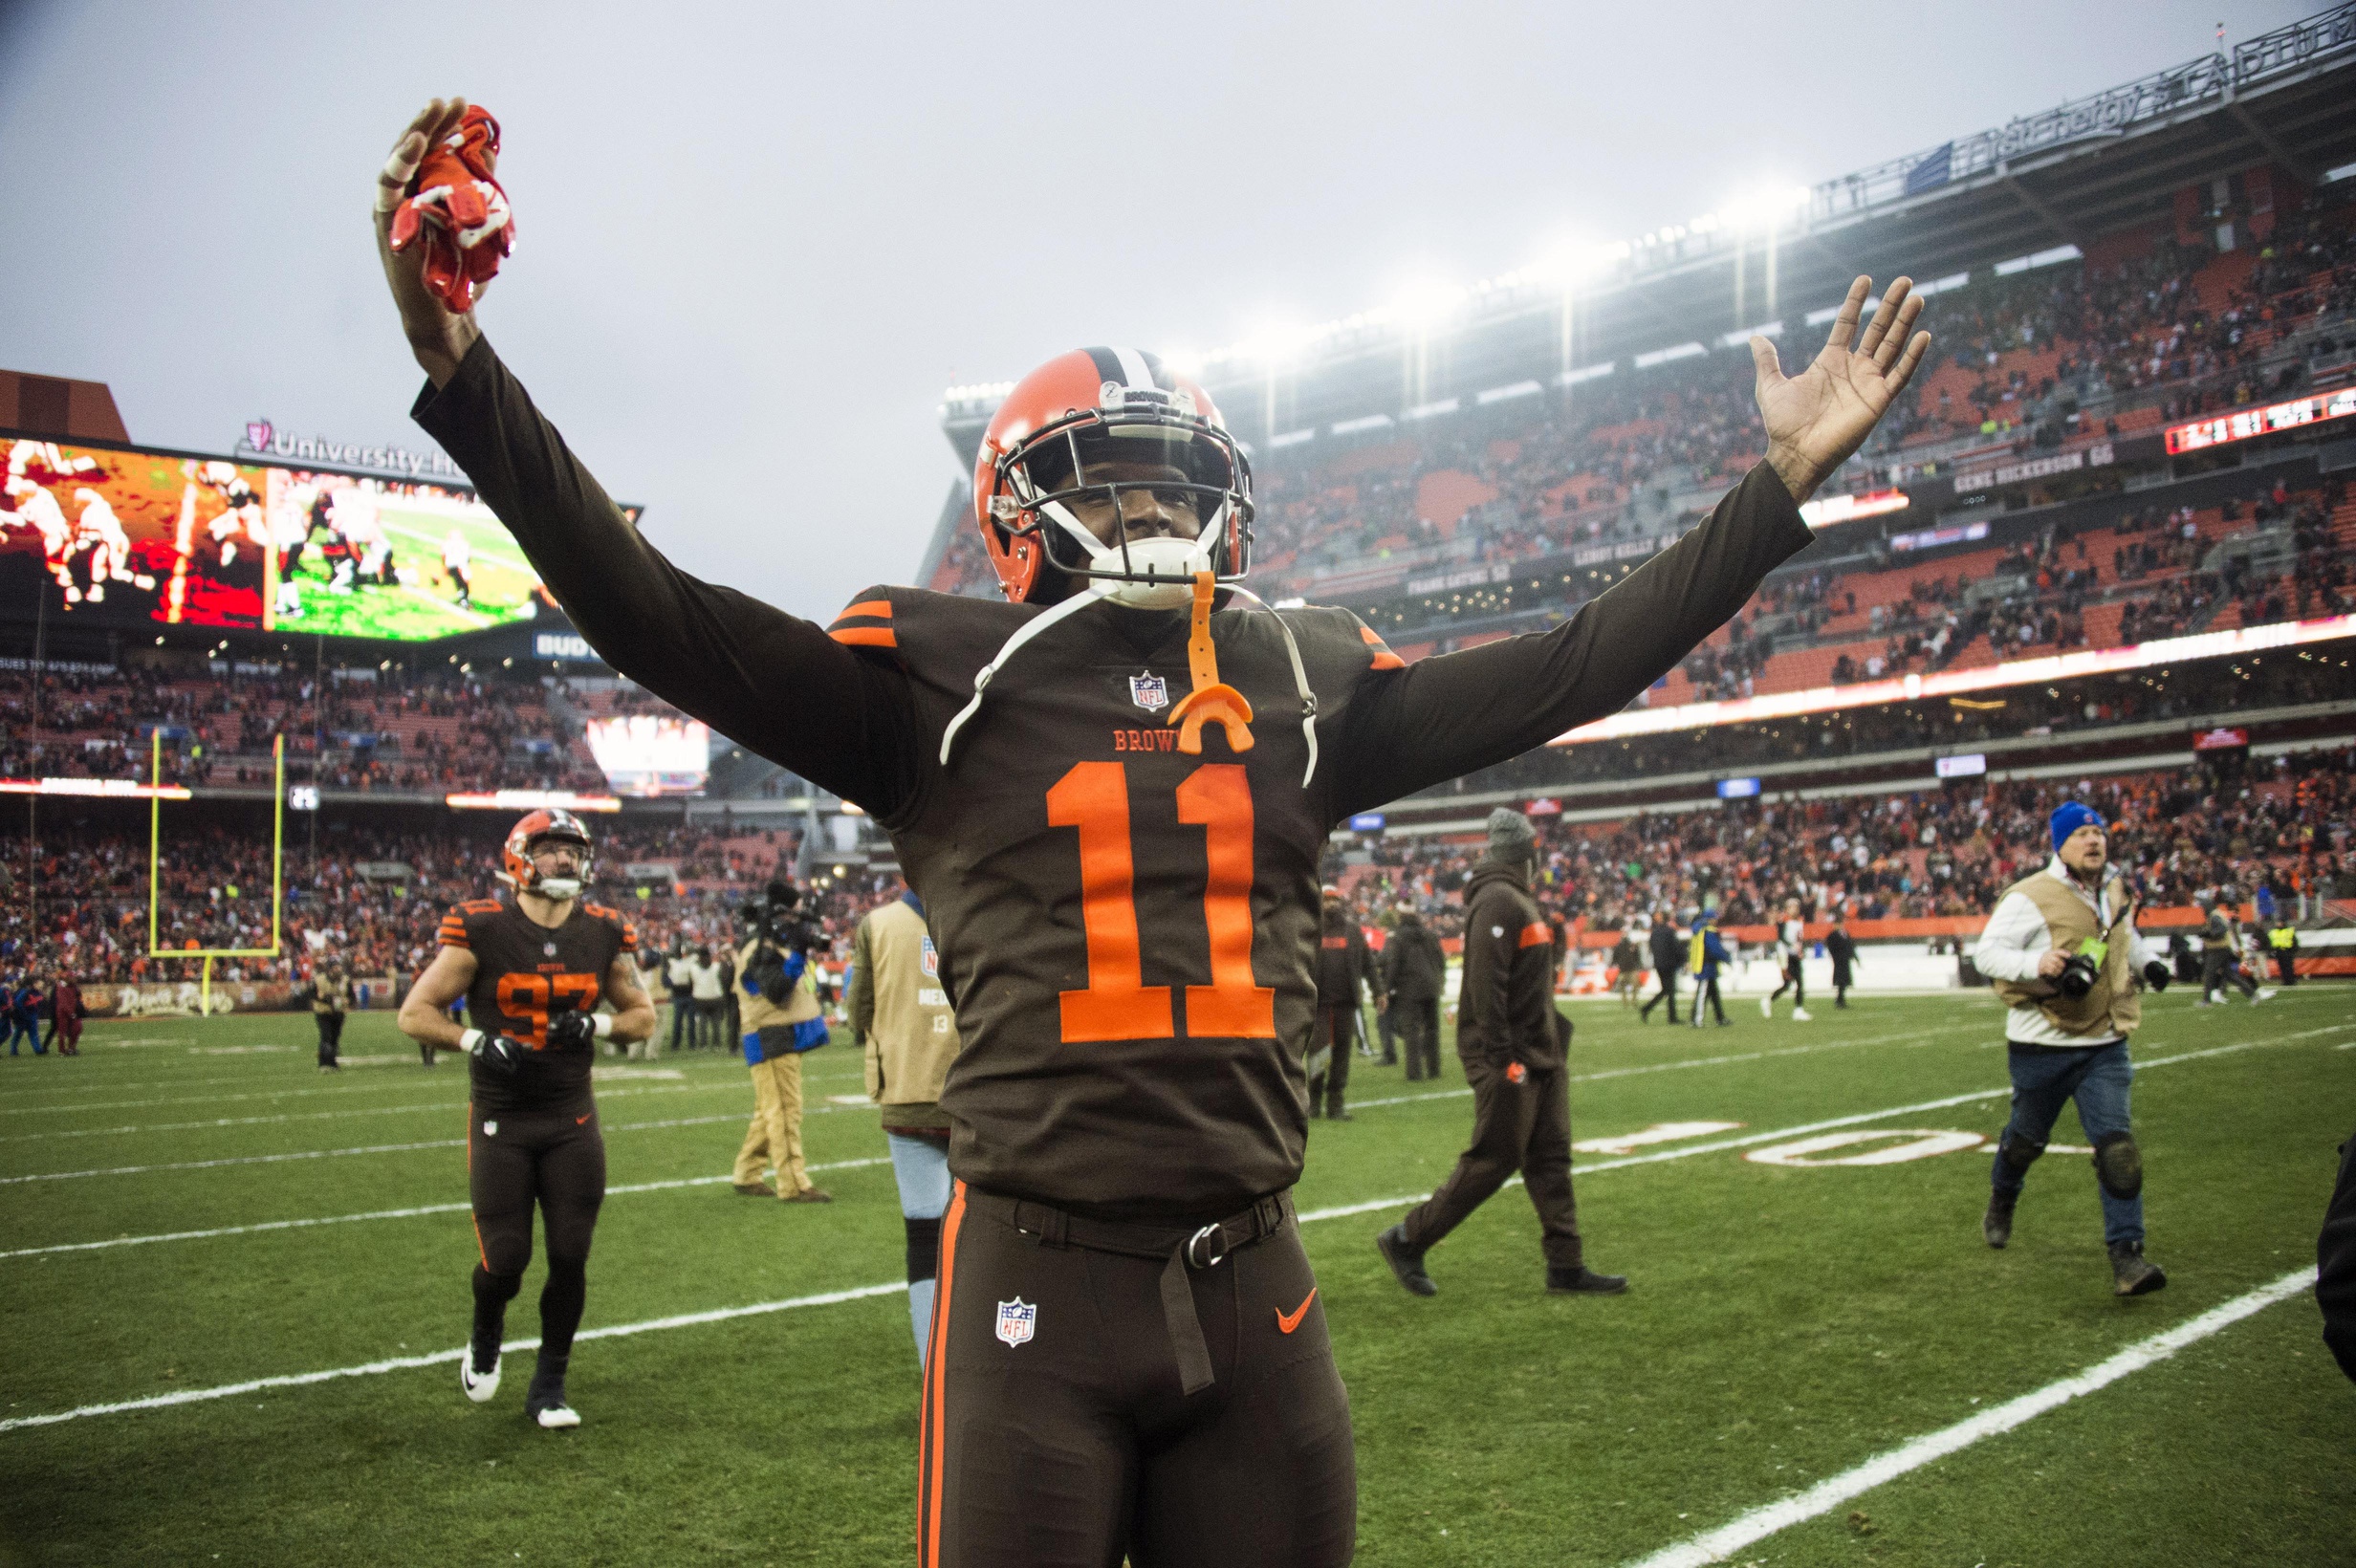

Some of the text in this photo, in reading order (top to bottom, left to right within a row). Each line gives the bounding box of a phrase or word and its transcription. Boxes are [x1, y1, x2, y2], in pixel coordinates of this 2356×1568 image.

[273, 431, 424, 475] University
[537, 634, 601, 659] BUD
[1138, 689, 1163, 706] NFL
[1113, 730, 1182, 751] BROW
[1046, 761, 1276, 1043] 11
[496, 971, 599, 1051] 97
[933, 1014, 949, 1034] 13
[1002, 1319, 1029, 1339] NFL
